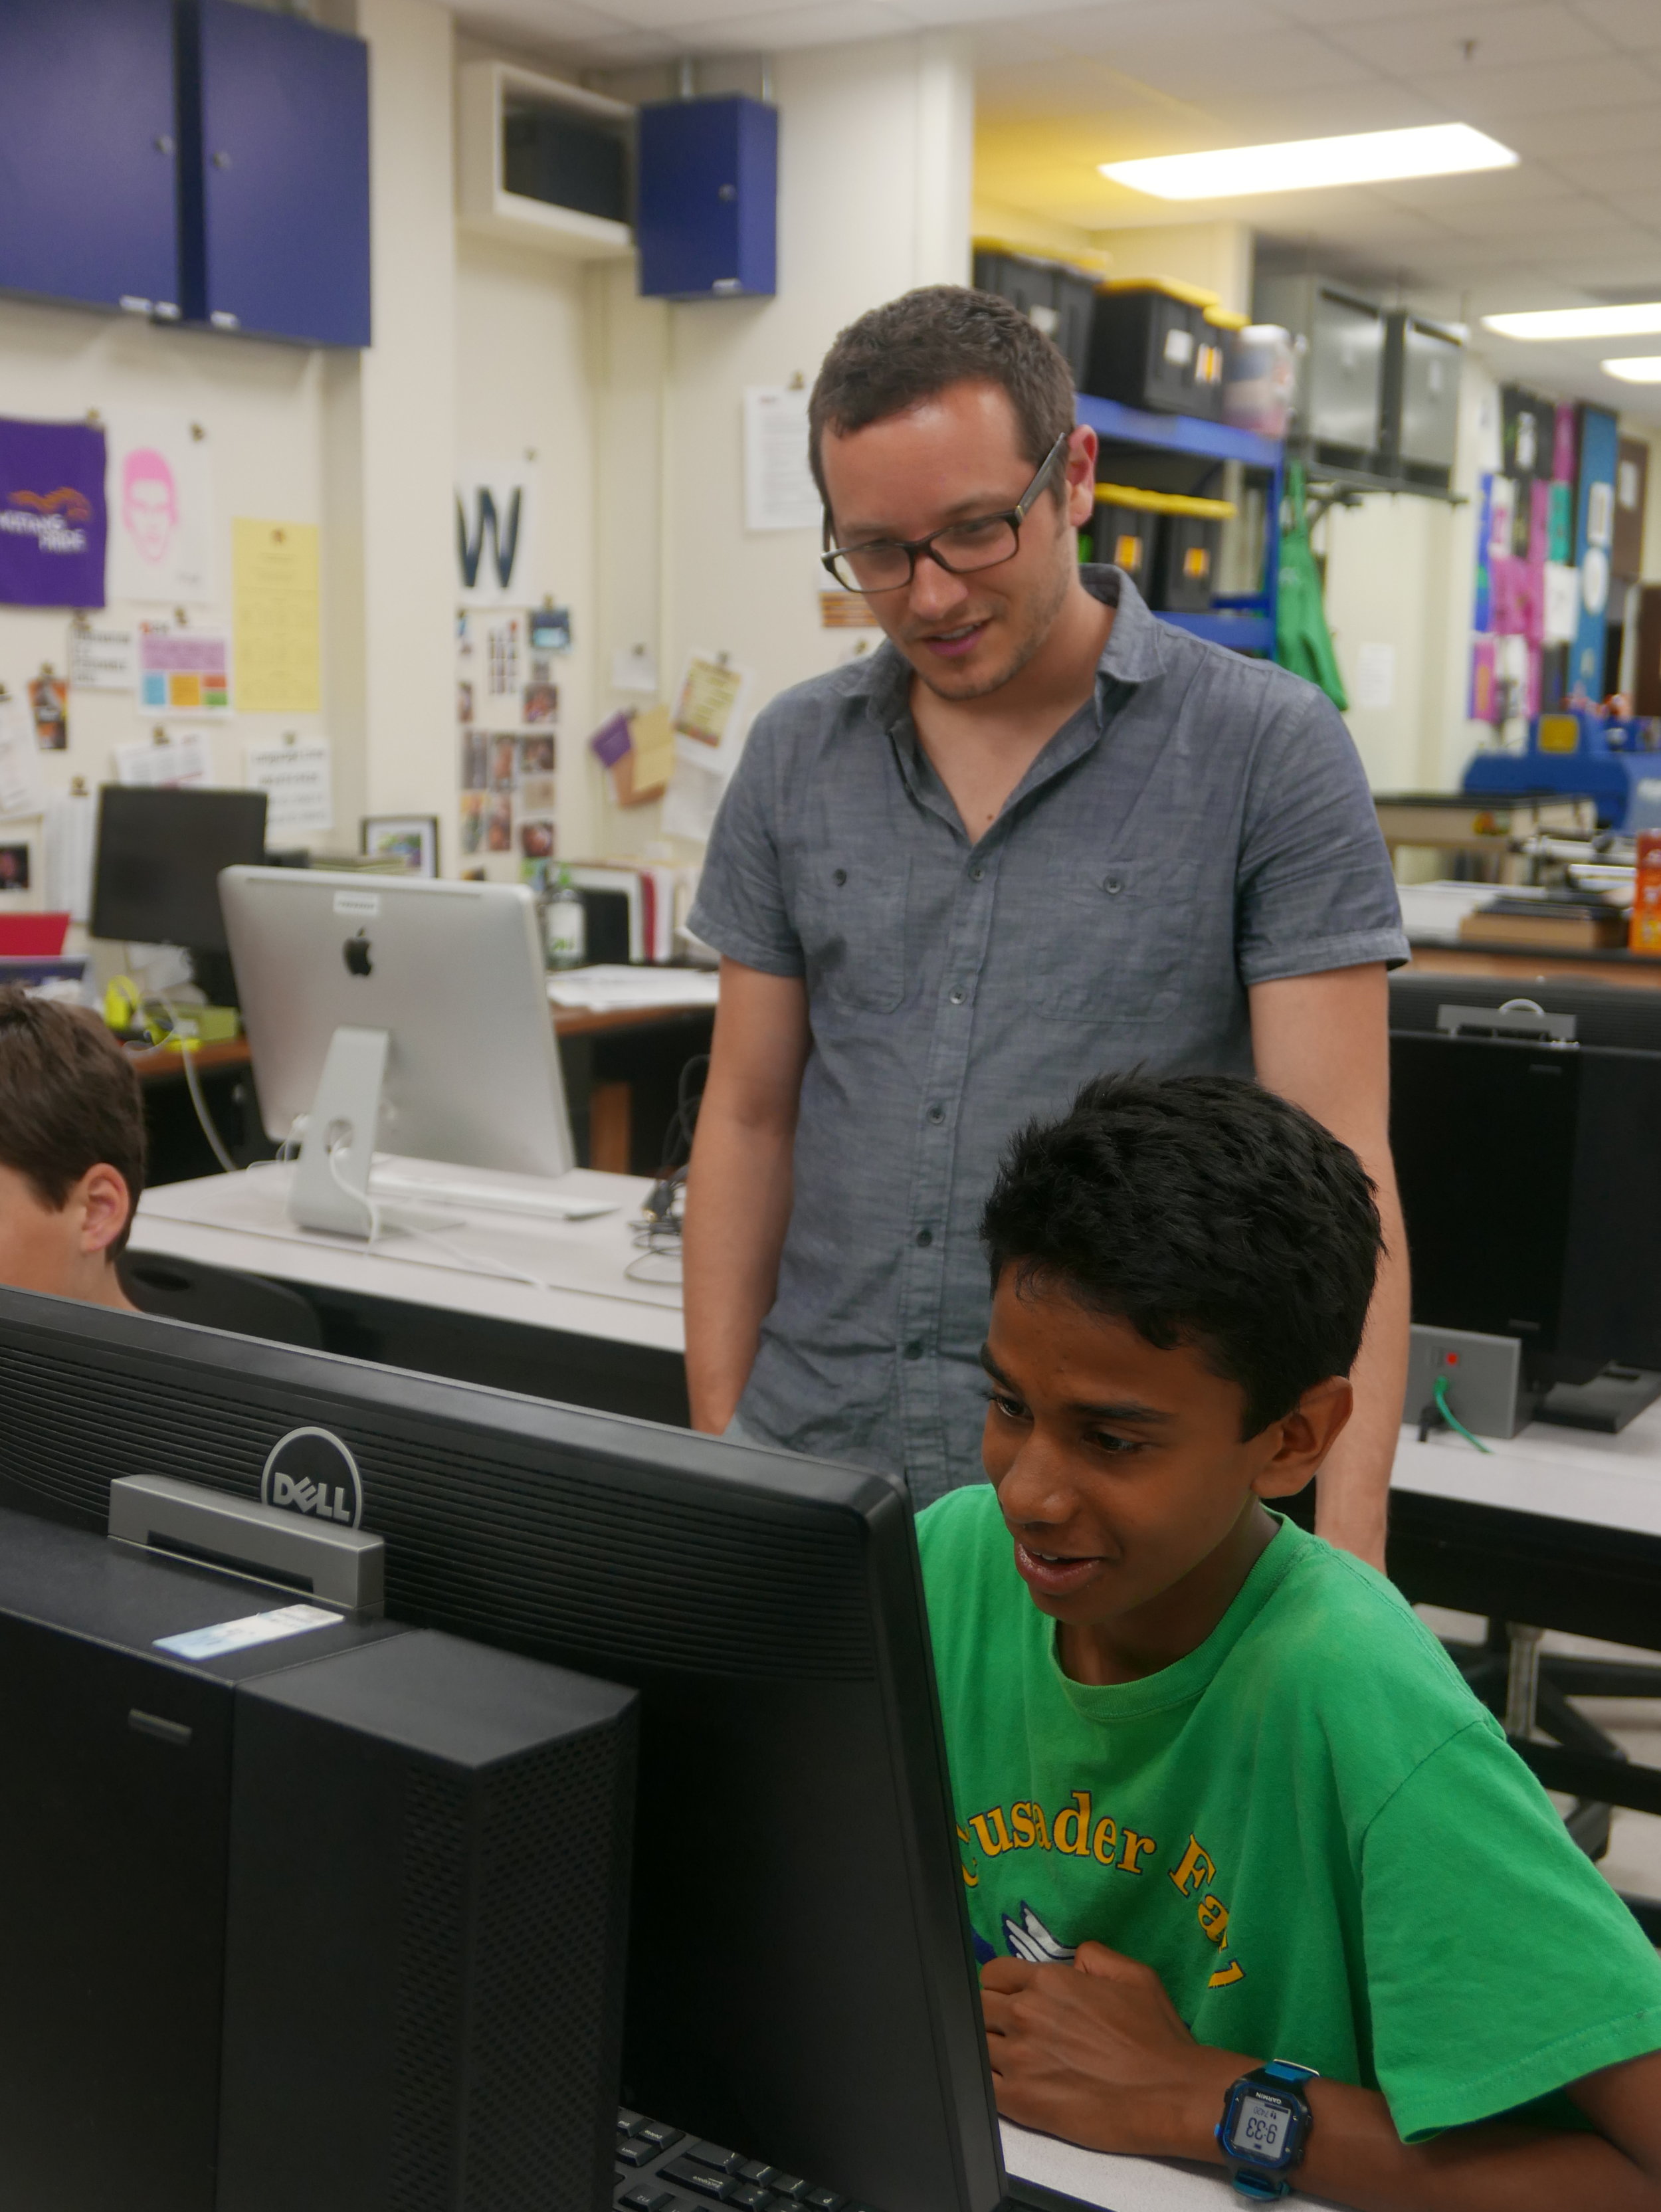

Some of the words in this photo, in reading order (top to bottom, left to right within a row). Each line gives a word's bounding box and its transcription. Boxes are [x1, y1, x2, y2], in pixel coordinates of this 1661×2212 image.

[455, 484, 522, 589] W
[273, 1472, 350, 1522] DELL
[1256, 2092, 1282, 2104] GARMIN
[1245, 2116, 1278, 2145] 9:33
